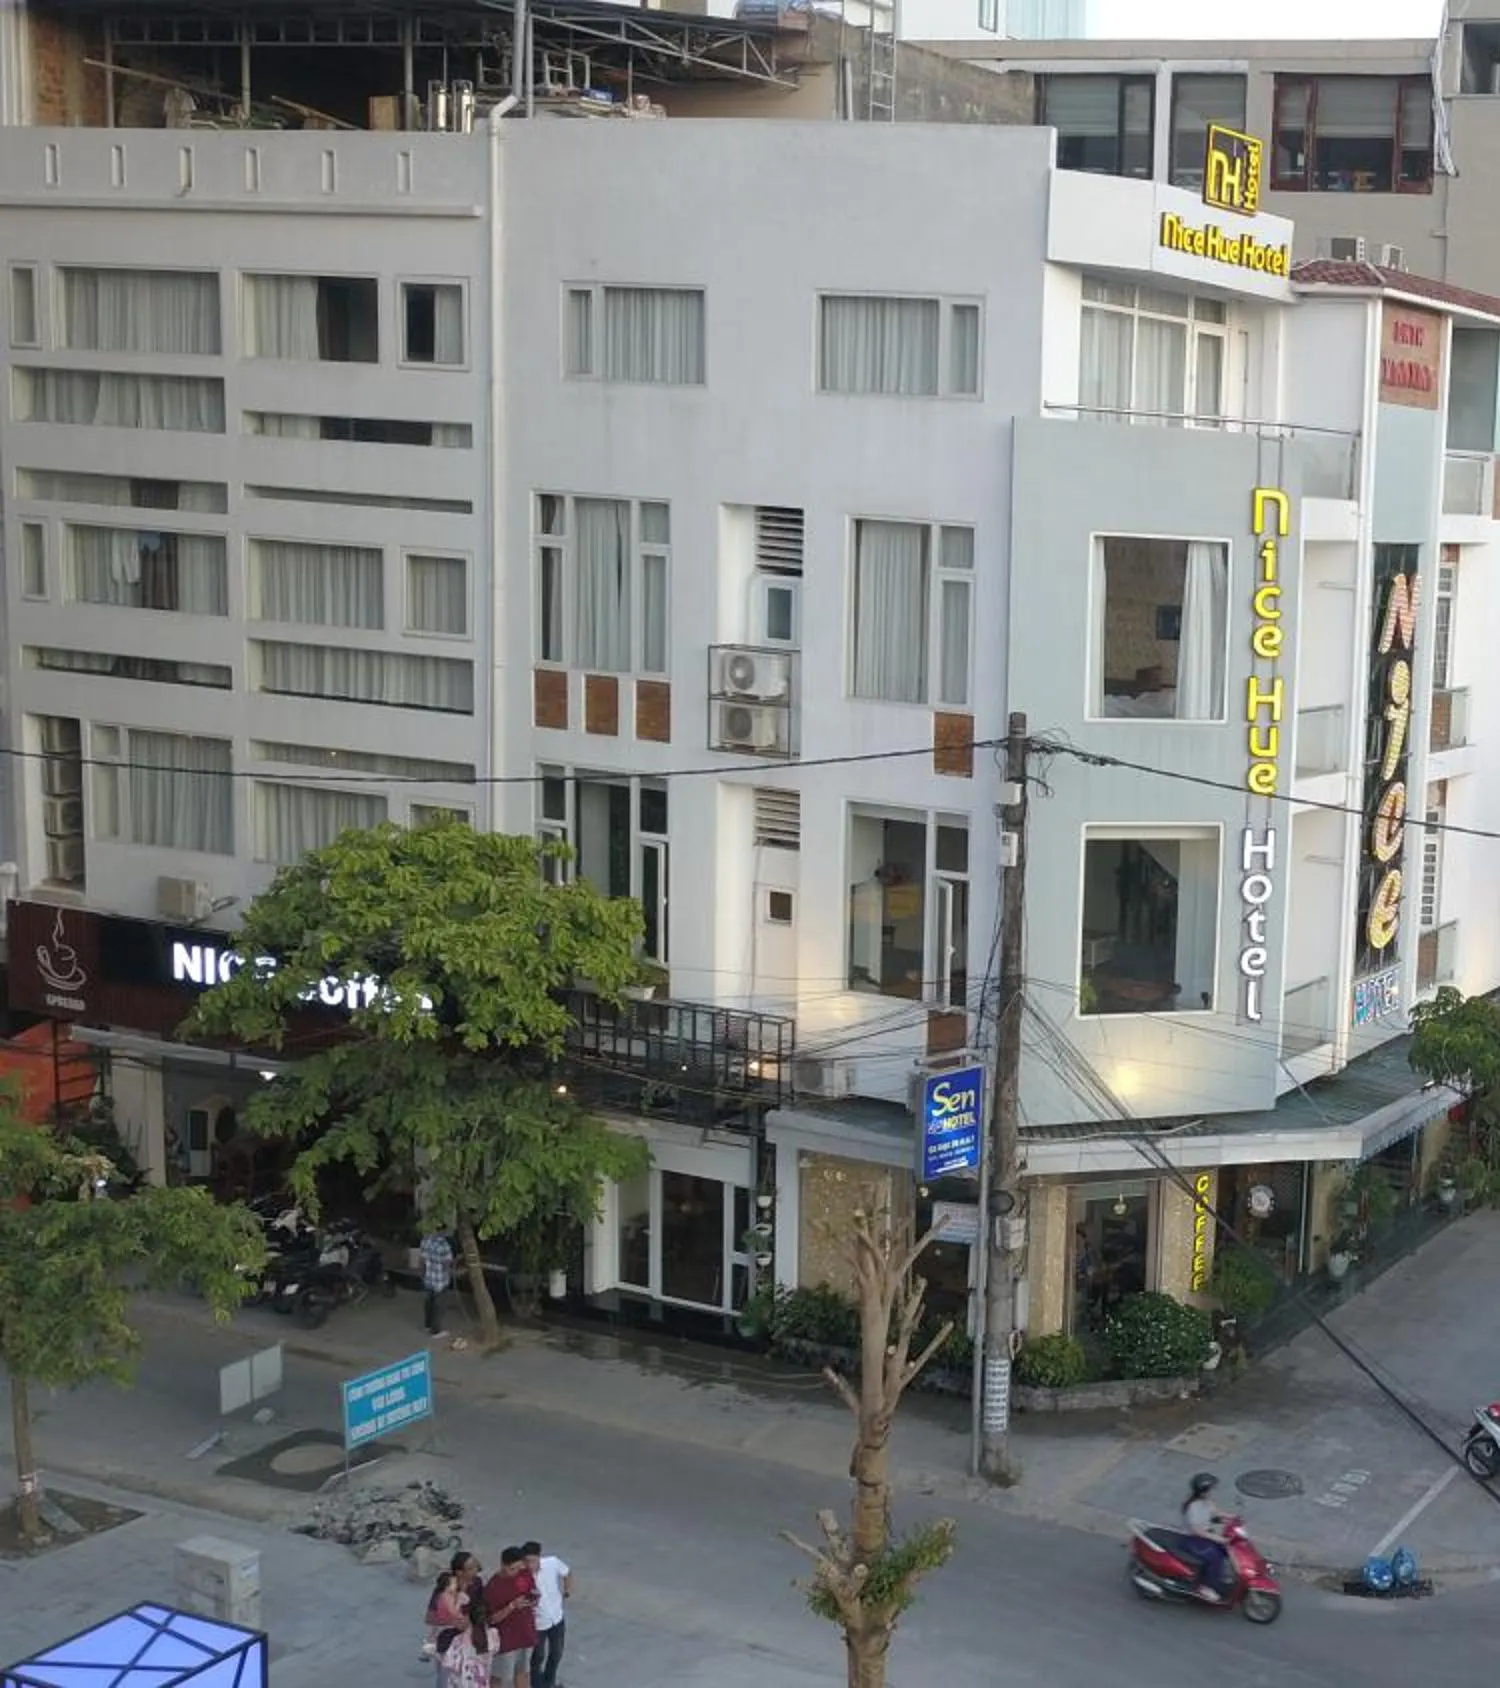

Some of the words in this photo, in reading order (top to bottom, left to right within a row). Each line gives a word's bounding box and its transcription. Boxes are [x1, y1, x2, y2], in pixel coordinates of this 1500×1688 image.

[1243, 144, 1260, 210] Hotel
[1205, 224, 1241, 264] Hue
[1241, 233, 1288, 276] Hotel
[1246, 675, 1284, 798] Hue
[1241, 828, 1276, 1020] Hotel
[297, 970, 434, 1013] off
[931, 1081, 976, 1117] Sen
